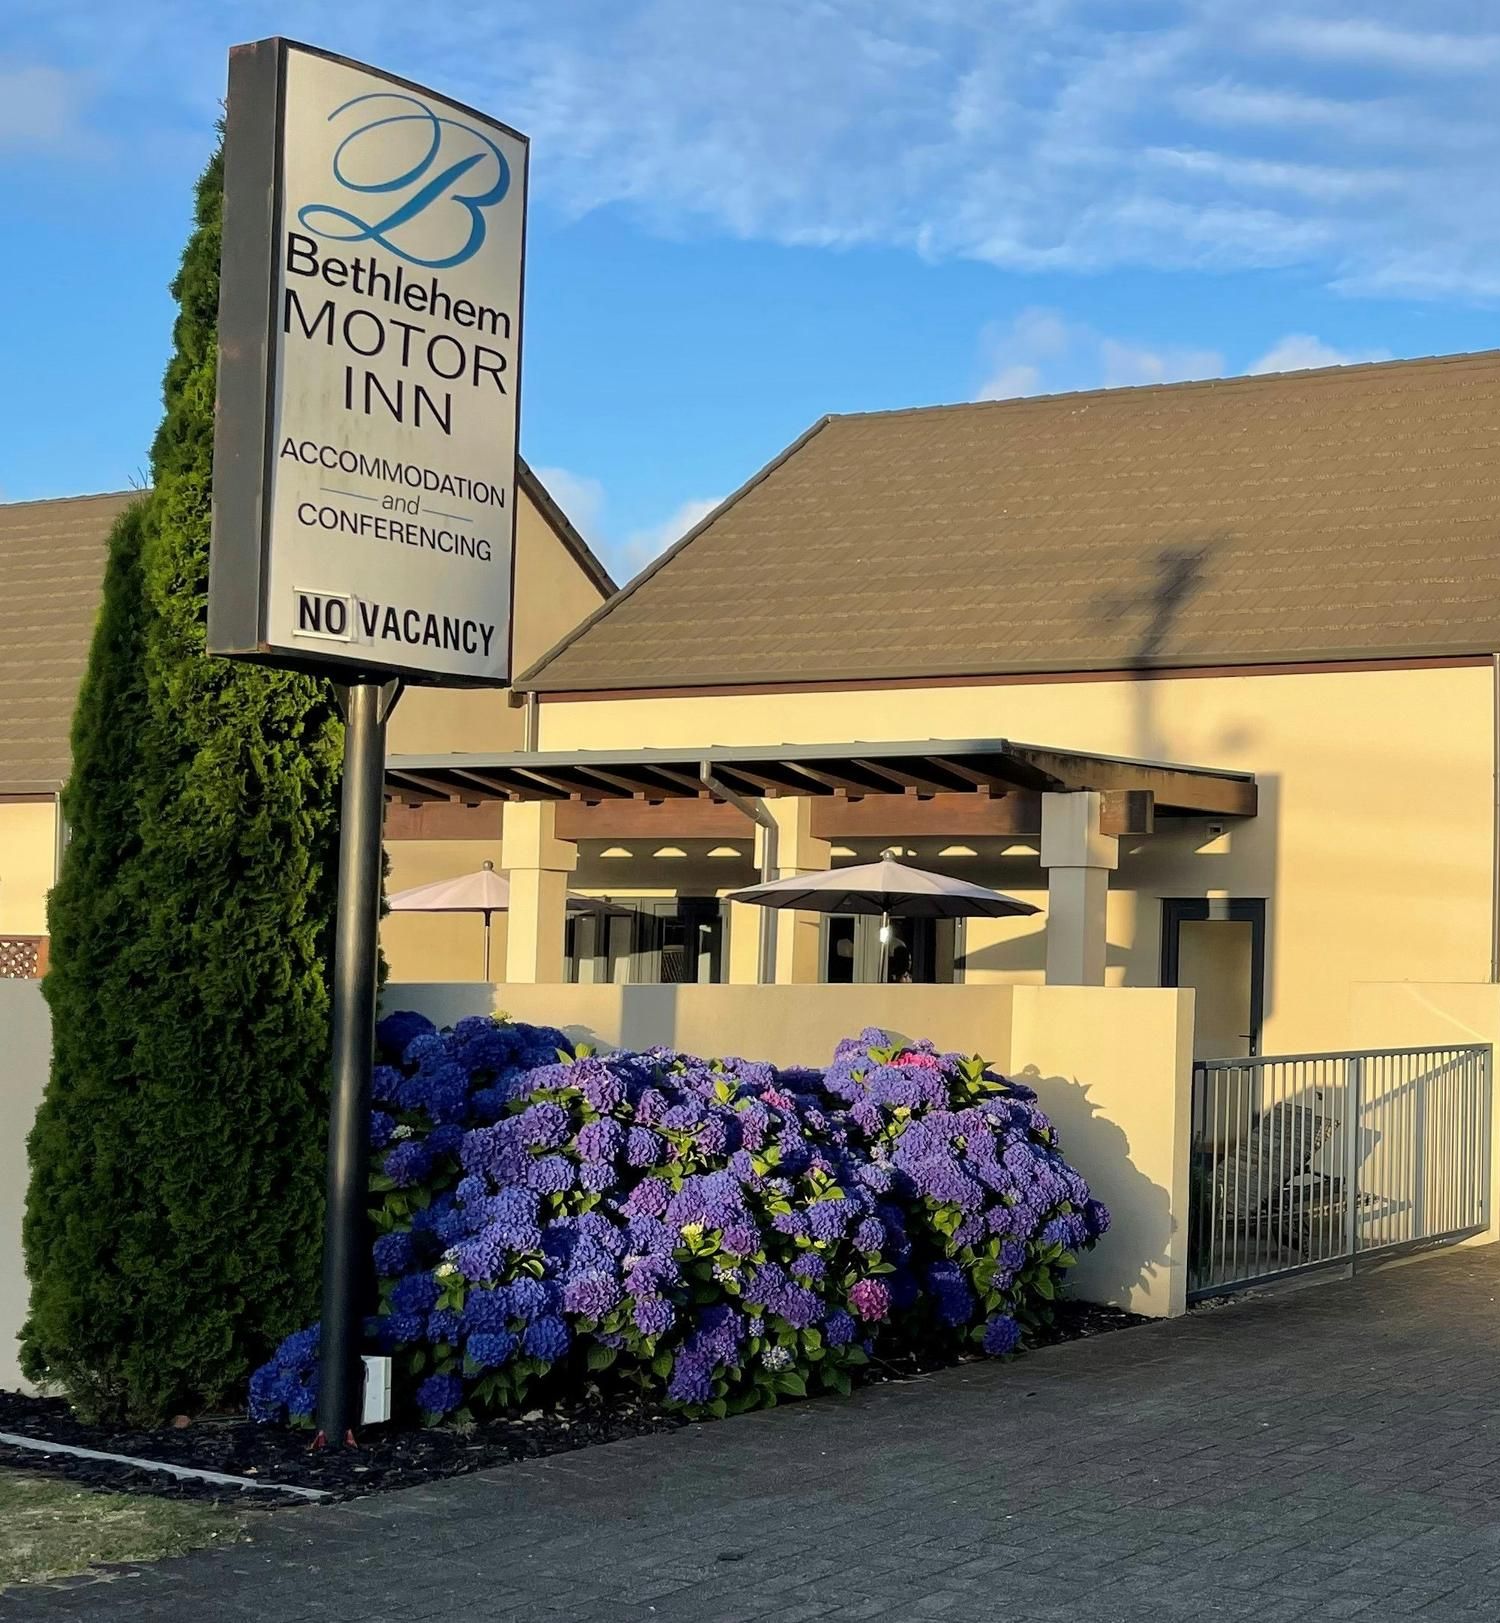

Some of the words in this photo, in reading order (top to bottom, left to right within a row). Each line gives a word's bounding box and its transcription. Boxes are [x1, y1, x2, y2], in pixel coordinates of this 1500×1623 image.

[286, 231, 511, 338] Bethlehem
[283, 287, 507, 395] MOTOR
[345, 366, 451, 435] INN
[280, 437, 505, 508] ACCOMMODATION
[381, 494, 420, 516] and
[297, 502, 491, 562] CONFERENCING
[299, 595, 346, 635] NO
[360, 601, 495, 657] VACANCY
